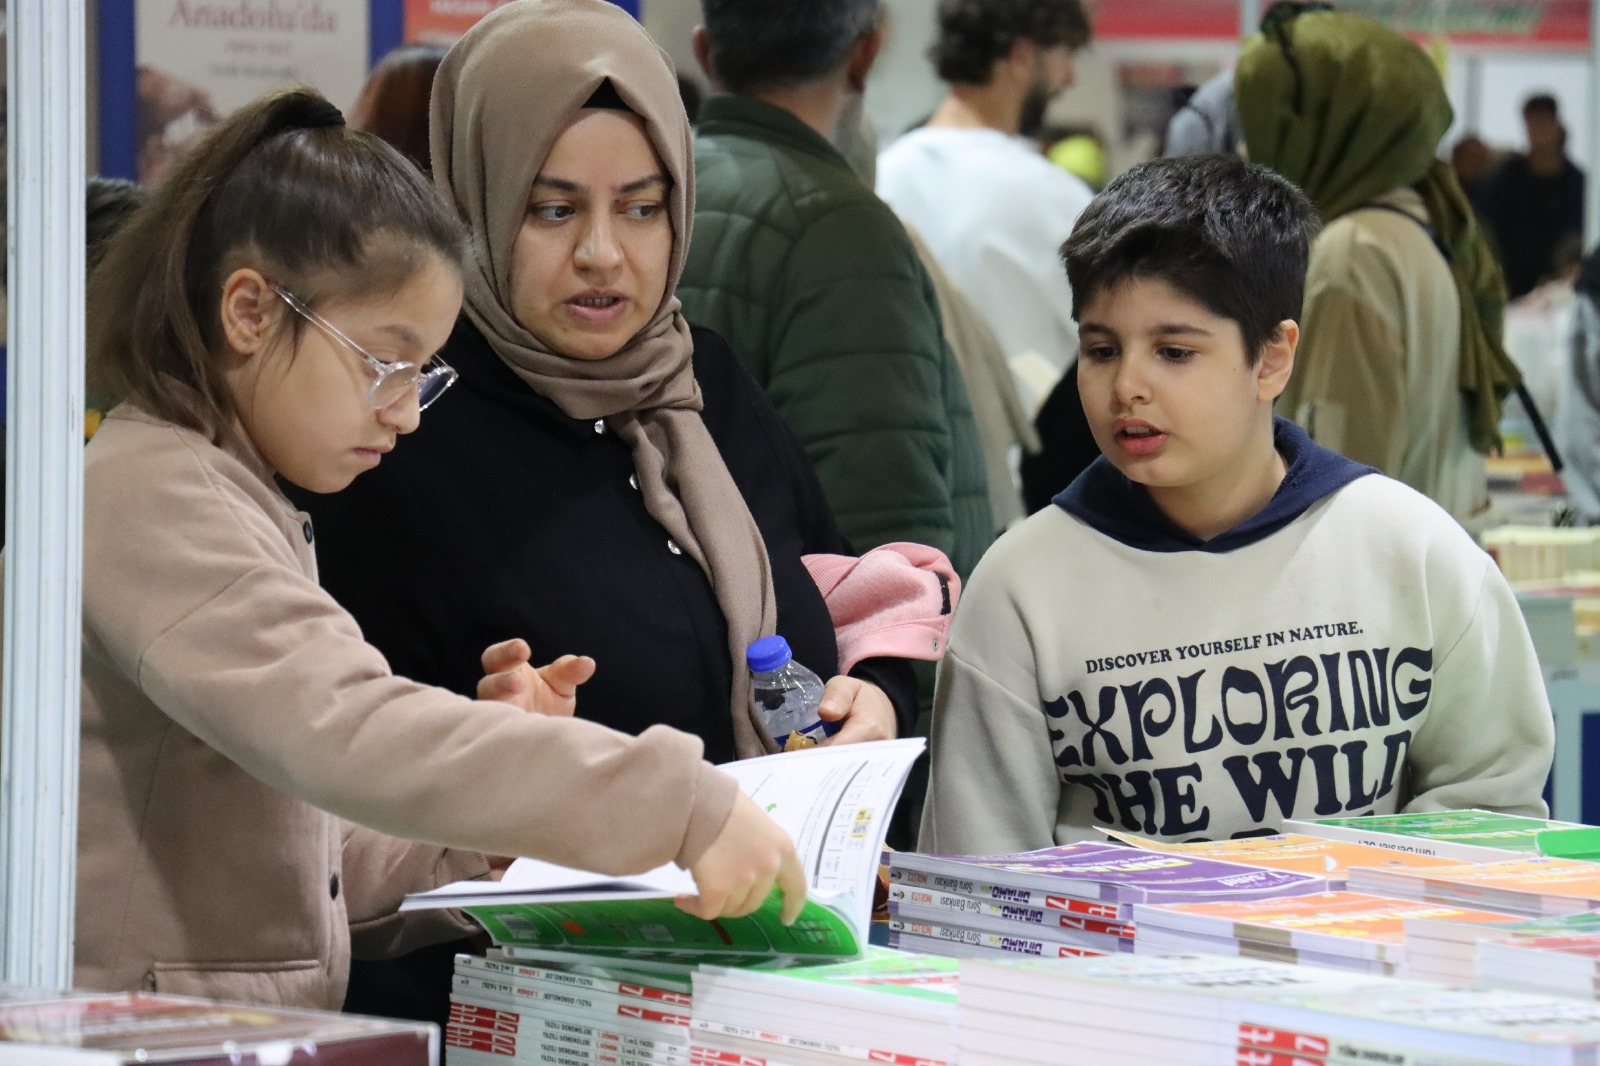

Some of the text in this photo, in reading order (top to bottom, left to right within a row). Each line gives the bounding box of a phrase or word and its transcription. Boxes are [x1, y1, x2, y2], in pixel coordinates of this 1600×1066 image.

[1086, 621, 1363, 674] DISCOVER YOURSELF IN NATURE.
[1045, 647, 1433, 767] EXPLORING
[1064, 762, 1210, 836] THE
[958, 880, 974, 893] Soru
[940, 897, 965, 912] Bankası
[966, 900, 982, 914] Soru
[940, 928, 965, 943] Bankası
[966, 931, 982, 945] Soru
